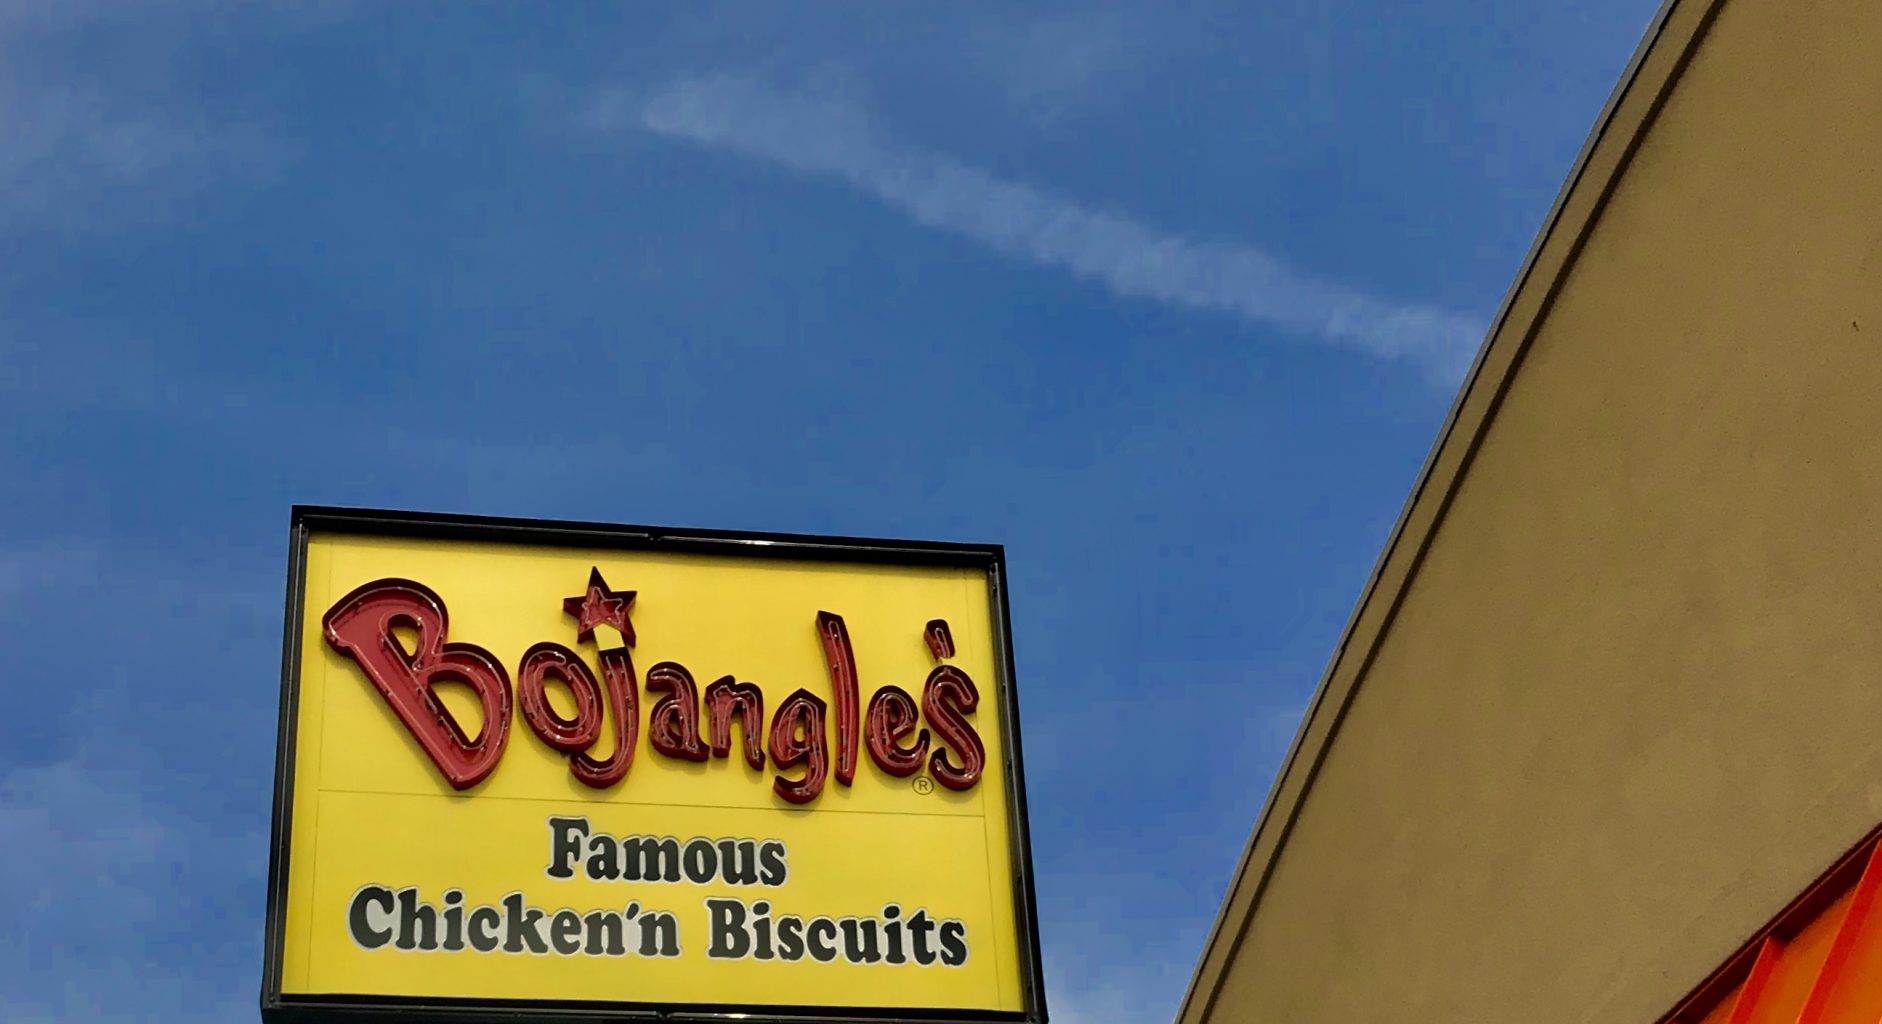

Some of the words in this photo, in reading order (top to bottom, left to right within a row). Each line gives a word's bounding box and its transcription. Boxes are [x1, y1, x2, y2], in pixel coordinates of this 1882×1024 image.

[322, 566, 986, 803] Bojangle's
[549, 817, 787, 886] Famous
[350, 886, 680, 956] Chicken'n
[707, 898, 968, 966] Biscuits
